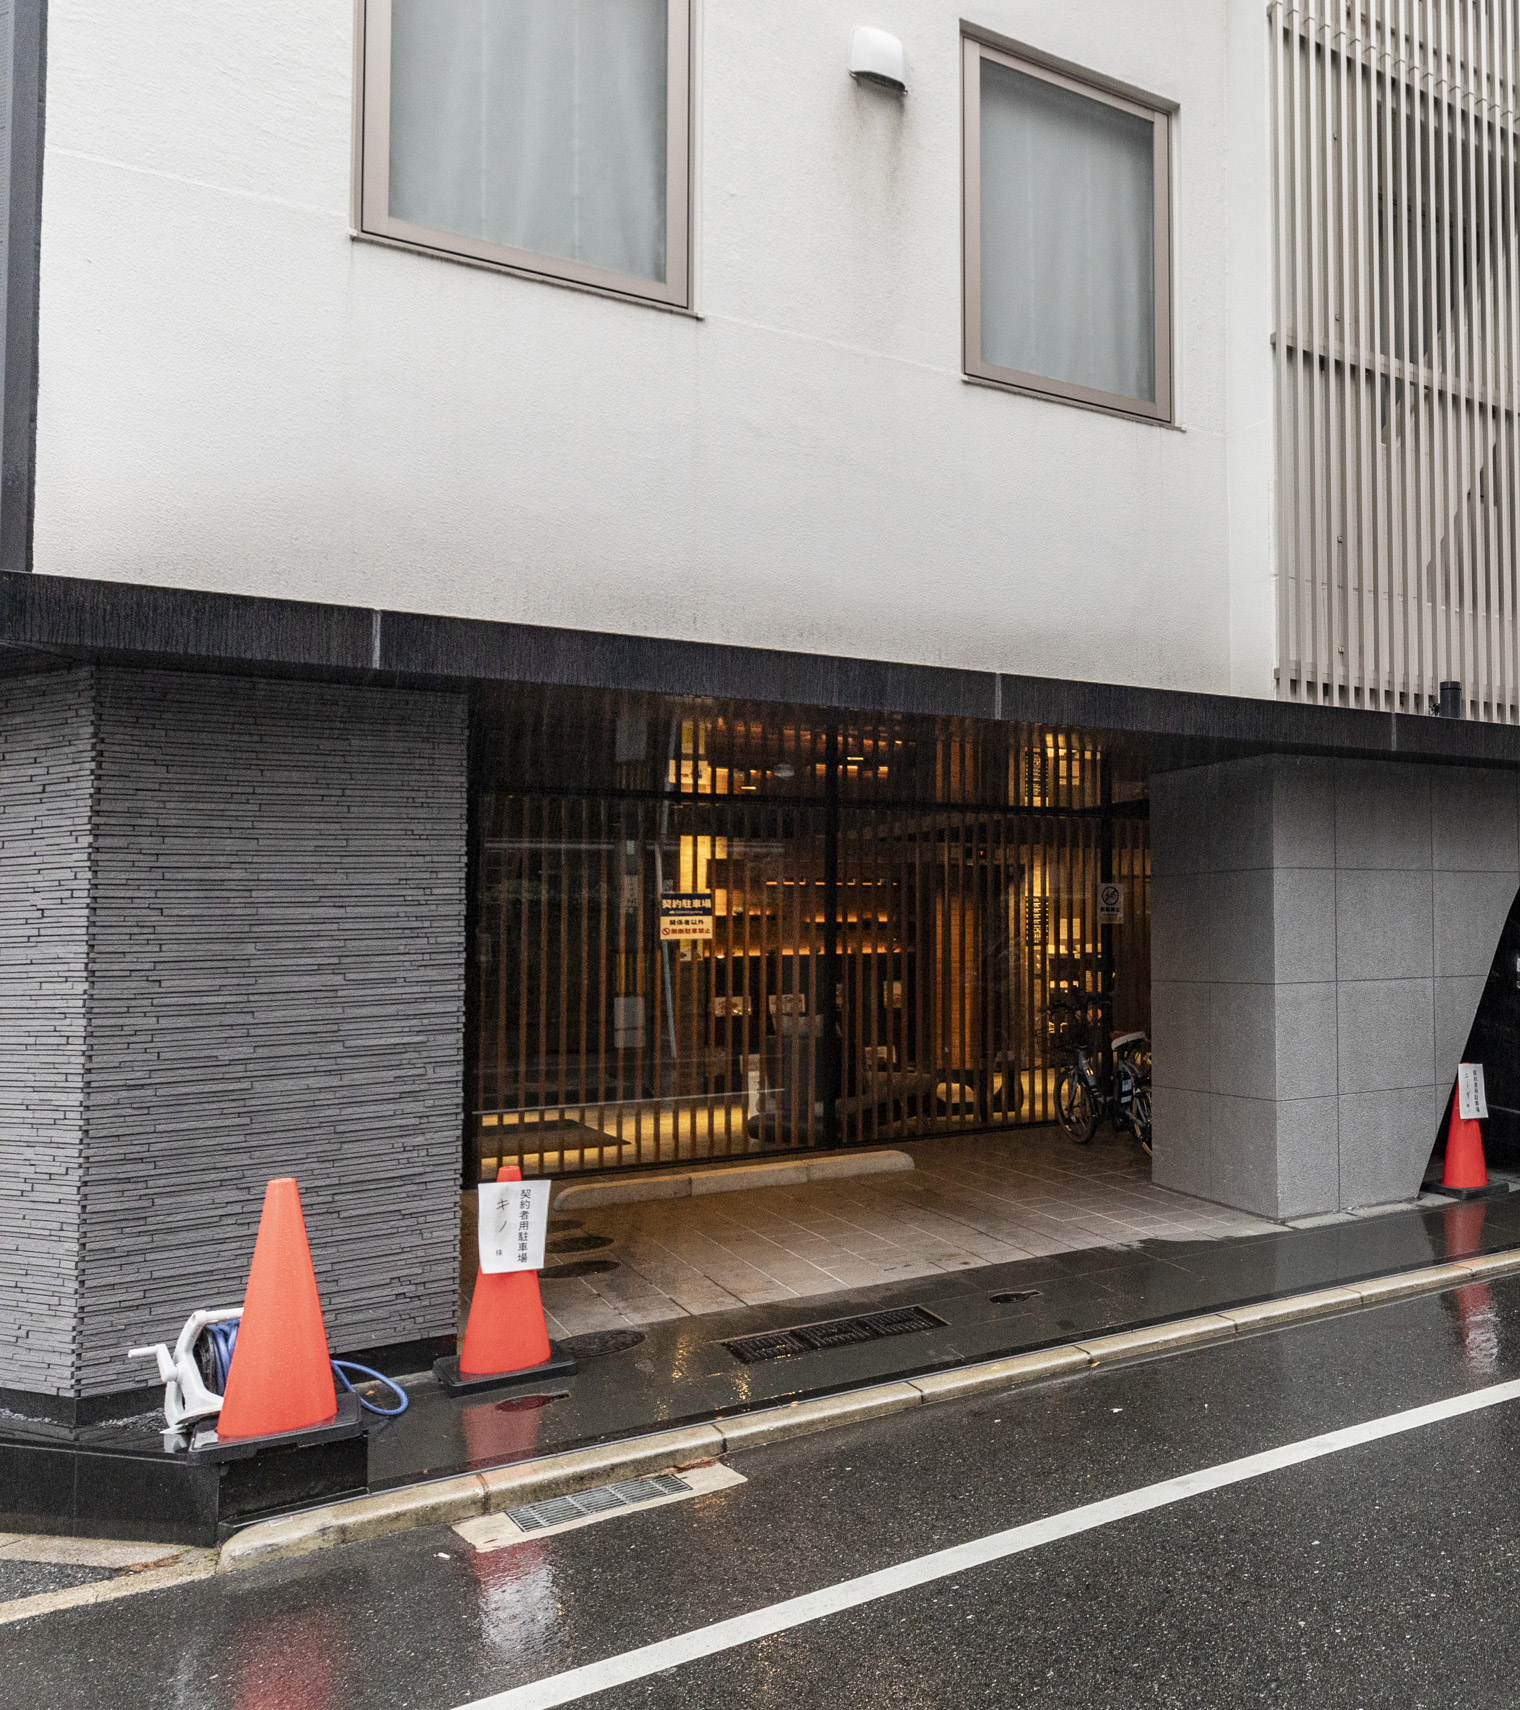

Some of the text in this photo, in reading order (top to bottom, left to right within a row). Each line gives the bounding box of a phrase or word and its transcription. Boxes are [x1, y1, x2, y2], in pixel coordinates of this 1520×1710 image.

[662, 898, 711, 909] 契約駐車場
[517, 1189, 531, 1263] 契約者用駐車場
